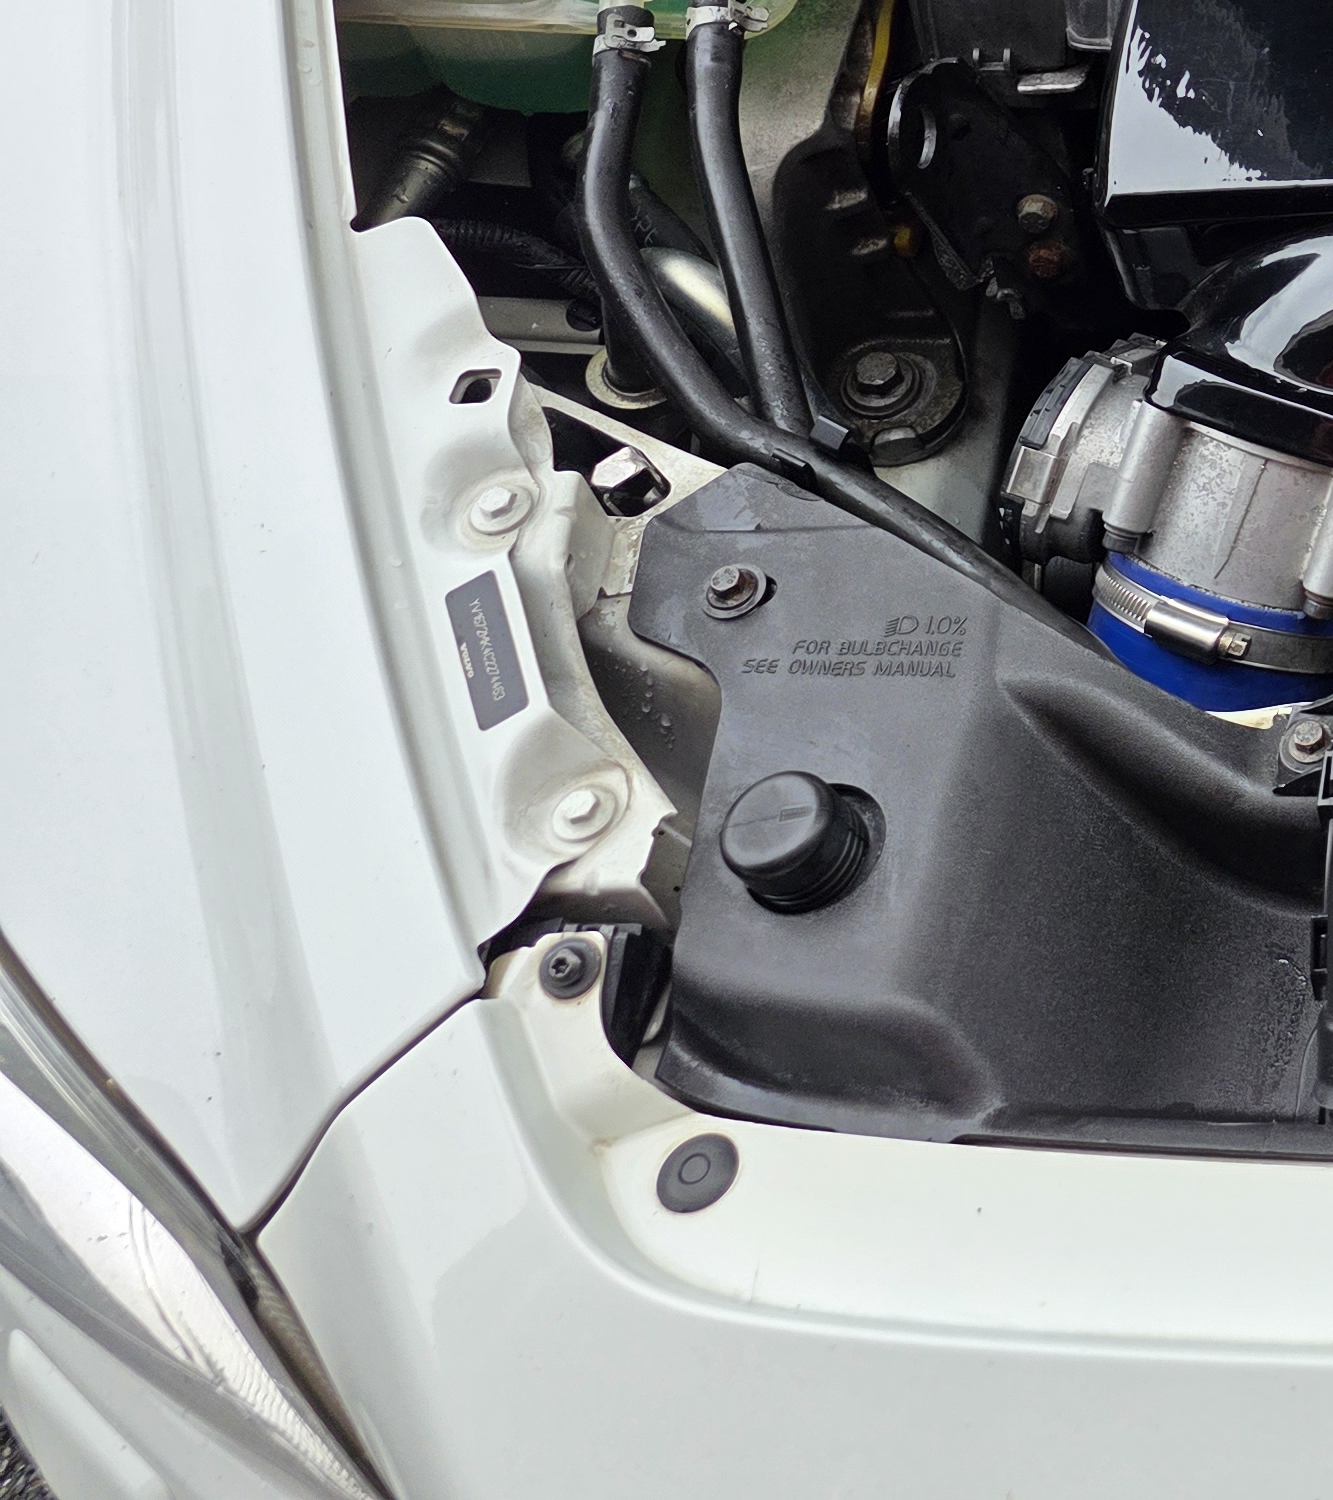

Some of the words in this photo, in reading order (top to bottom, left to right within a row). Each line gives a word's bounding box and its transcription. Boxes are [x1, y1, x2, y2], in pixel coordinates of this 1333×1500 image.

[924, 615, 968, 636] 1.0%
[791, 639, 831, 654] FOR
[837, 639, 964, 657] BULBCHANGE
[459, 642, 475, 678] VOLVO
[741, 658, 780, 674] SEE
[787, 658, 867, 677] OWNERS
[872, 659, 956, 678] MANUAL
